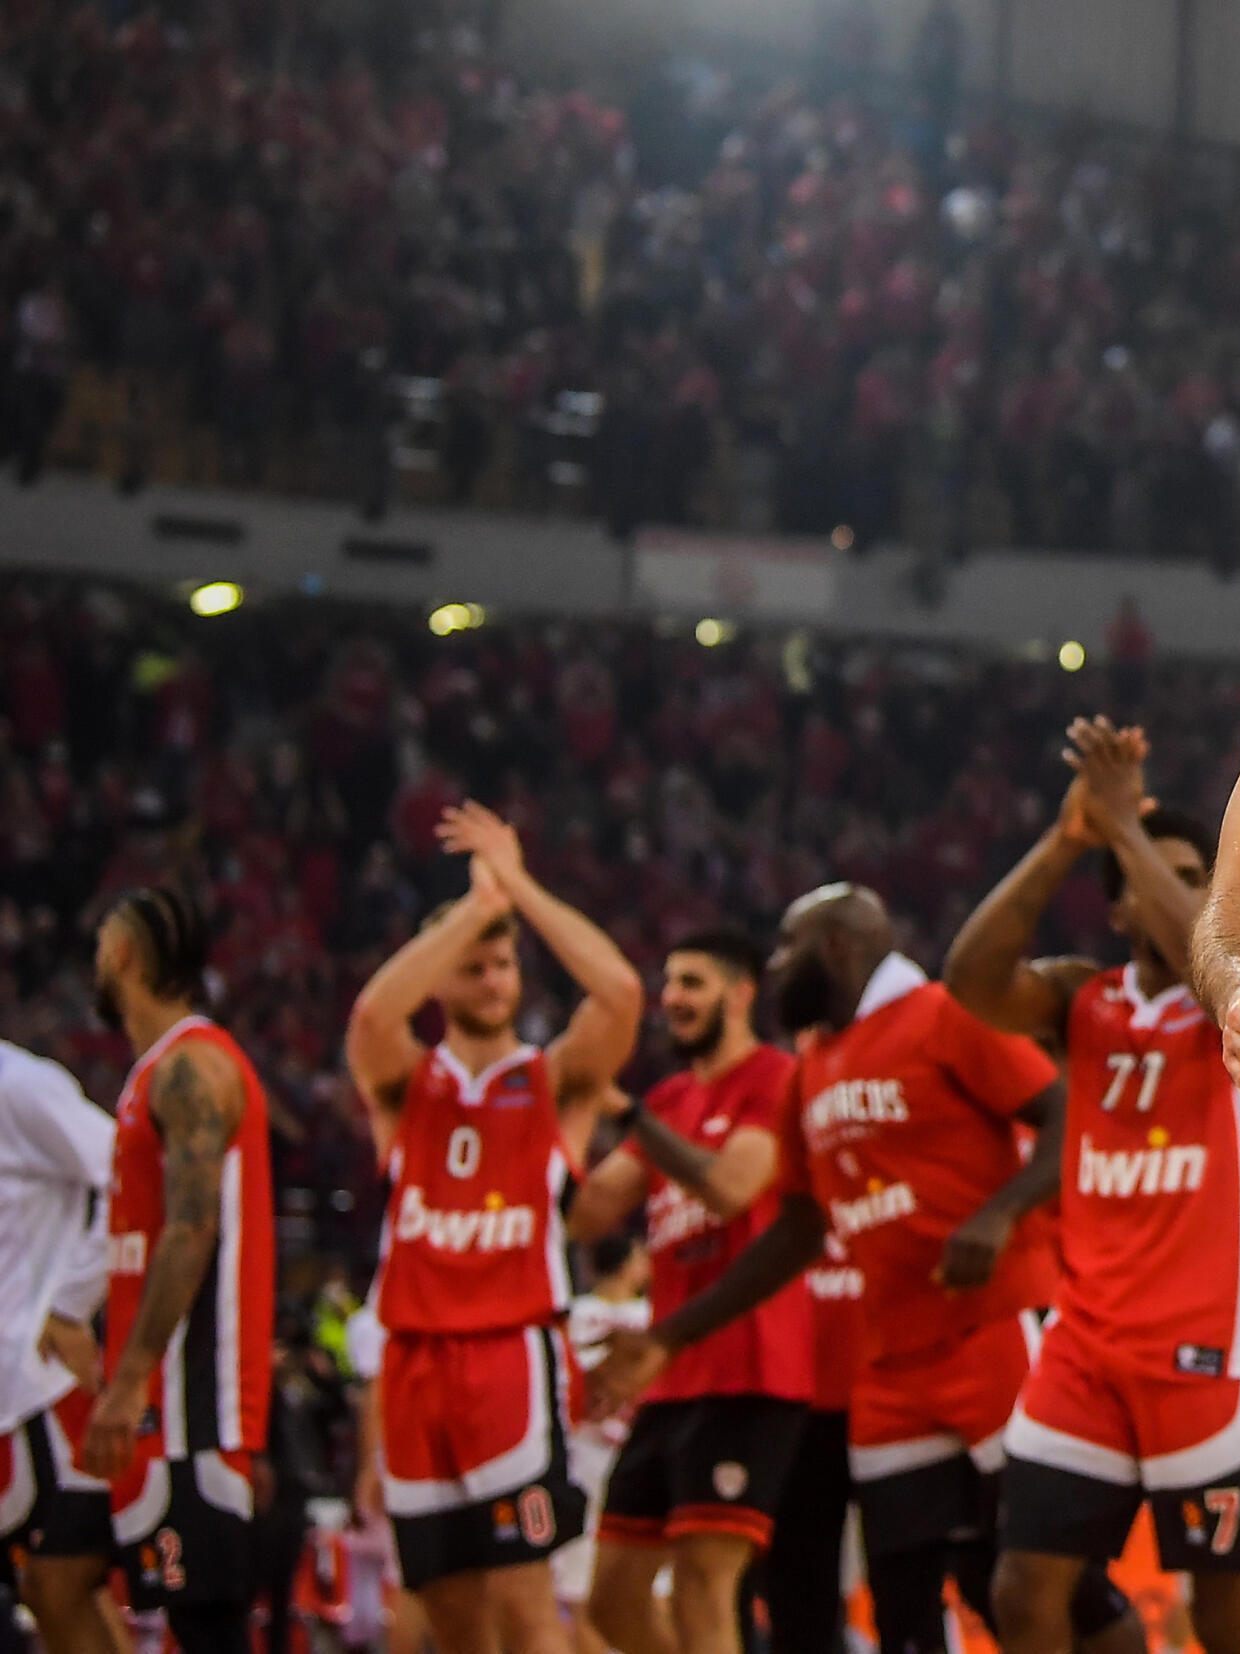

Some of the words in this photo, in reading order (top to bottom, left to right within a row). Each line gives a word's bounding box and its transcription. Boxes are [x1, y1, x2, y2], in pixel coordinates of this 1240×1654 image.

[446, 1126, 481, 1179] 0
[1078, 1127, 1207, 1196] bwin
[397, 1185, 534, 1252] bwin
[518, 1484, 556, 1547] 0
